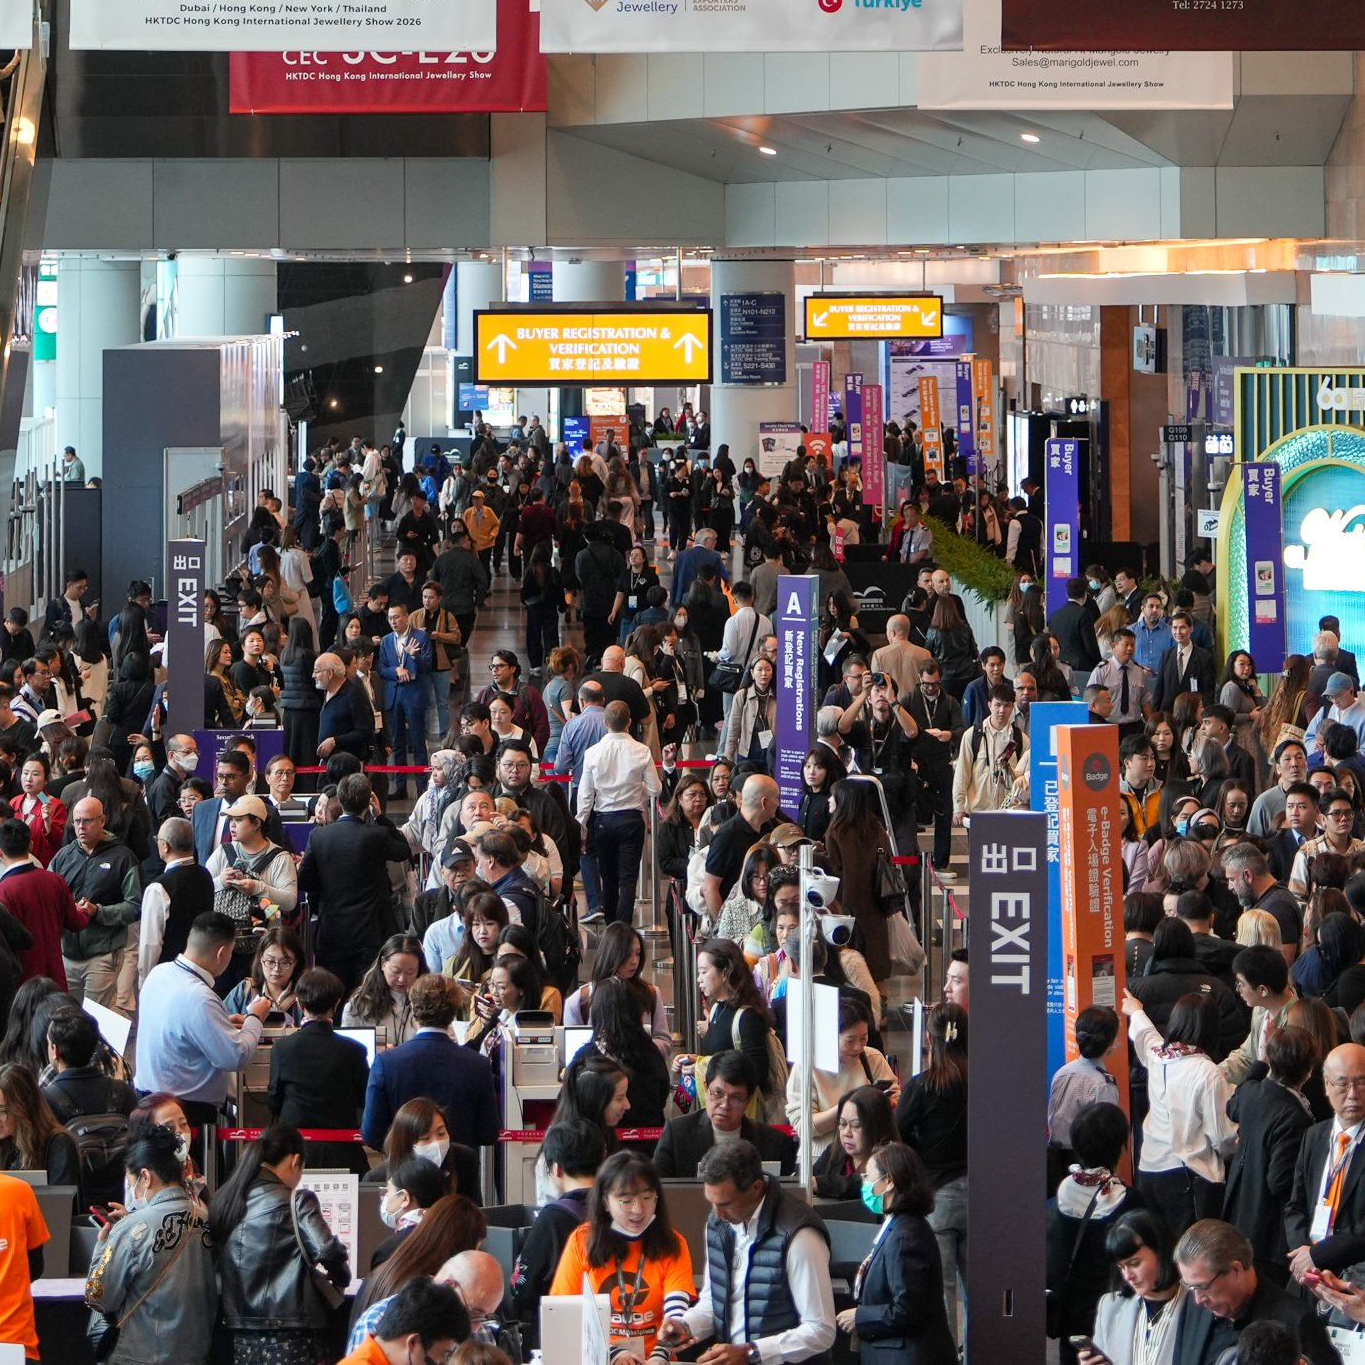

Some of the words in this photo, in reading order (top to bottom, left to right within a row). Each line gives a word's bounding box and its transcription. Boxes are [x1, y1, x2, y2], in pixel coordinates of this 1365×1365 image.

[616, 1, 678, 15] Jewellery
[692, 4, 746, 12] ASSOCIATION
[1172, 0, 1191, 10] Tel:
[1193, 0, 1217, 10] 2724
[1221, 0, 1244, 10] 1273
[1011, 57, 1139, 69] Sales@marigoldjewel.com
[829, 305, 854, 313] BUYER
[855, 305, 911, 313] REGISTRATION
[912, 305, 920, 313] &
[848, 314, 902, 322] VERIFICATION
[516, 327, 560, 340] BUYER
[562, 327, 658, 340] REGISTRATION
[660, 327, 672, 340] &
[549, 342, 640, 355] VERIFICATION
[548, 357, 640, 371] 買家登記及驗證
[1050, 443, 1060, 468] 買家
[1064, 442, 1075, 475] Buyer
[1247, 468, 1260, 497] 買家
[1263, 467, 1275, 504] Buyer
[174, 555, 200, 571] 出口
[177, 577, 198, 628] EXIT
[786, 591, 802, 615] A
[796, 630, 804, 657] New
[784, 629, 794, 689] 新登記買家
[795, 660, 804, 732] Registrations
[1085, 771, 1109, 782] Badge
[1044, 779, 1060, 863] 已登記買家
[1100, 805, 1111, 866] e-Badge
[981, 843, 1037, 874] 出口
[1086, 807, 1101, 914] 電子入場證驗證
[1102, 867, 1113, 949] Verification
[991, 891, 1031, 995] EXIT
